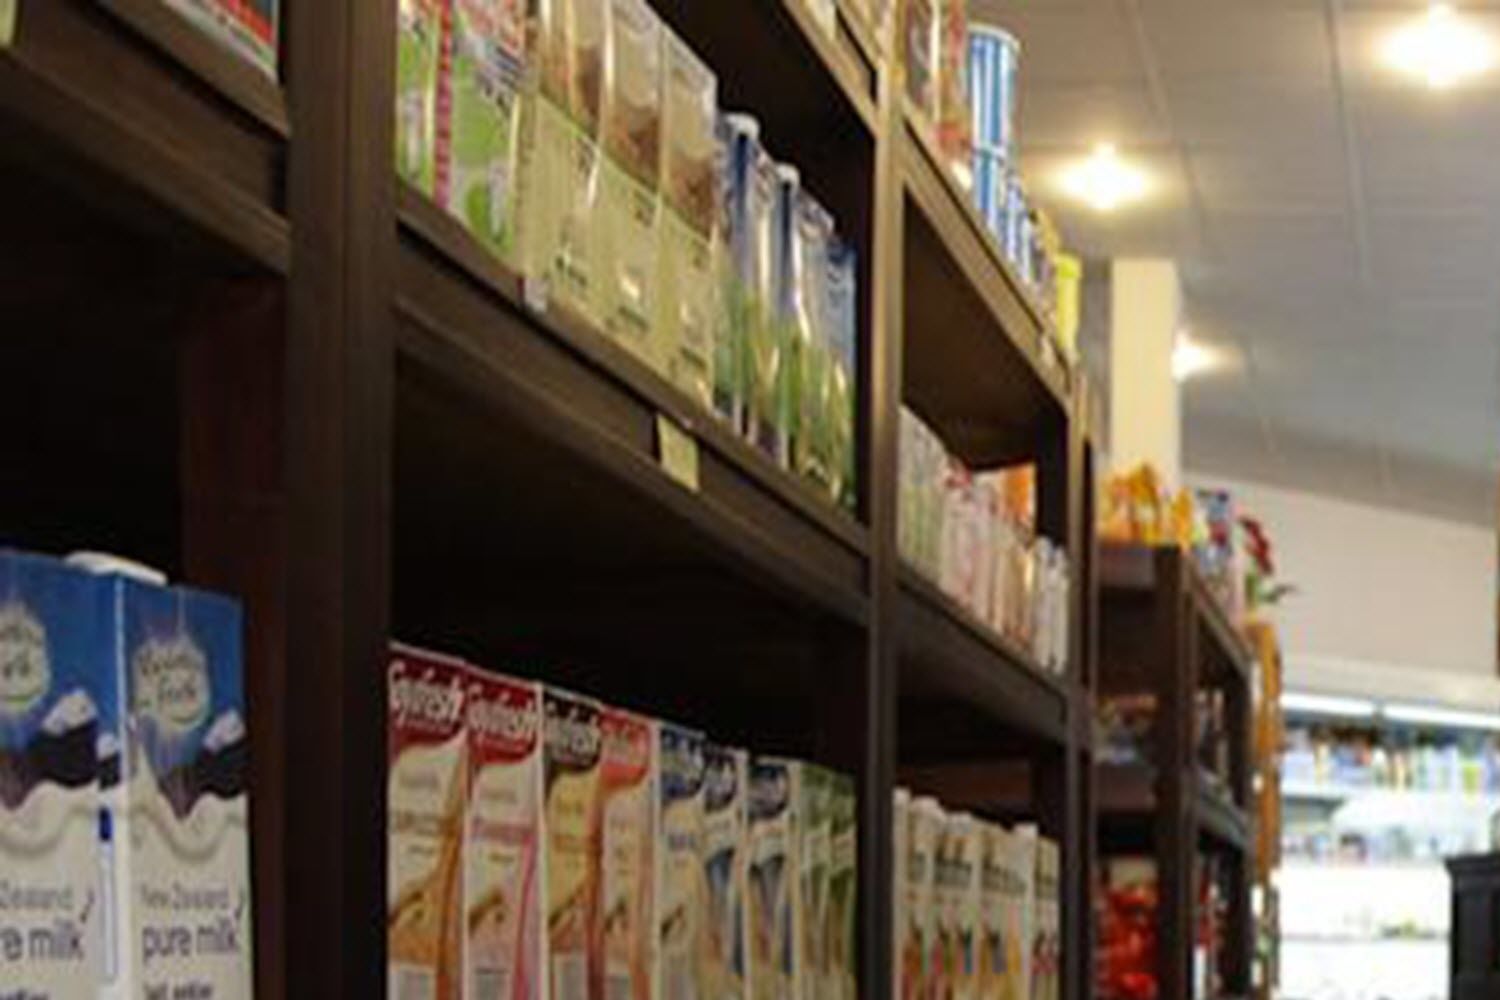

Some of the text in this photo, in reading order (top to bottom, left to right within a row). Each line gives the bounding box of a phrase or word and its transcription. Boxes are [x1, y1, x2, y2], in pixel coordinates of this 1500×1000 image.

[28, 917, 85, 960] milk
[142, 914, 240, 966] pure milk
